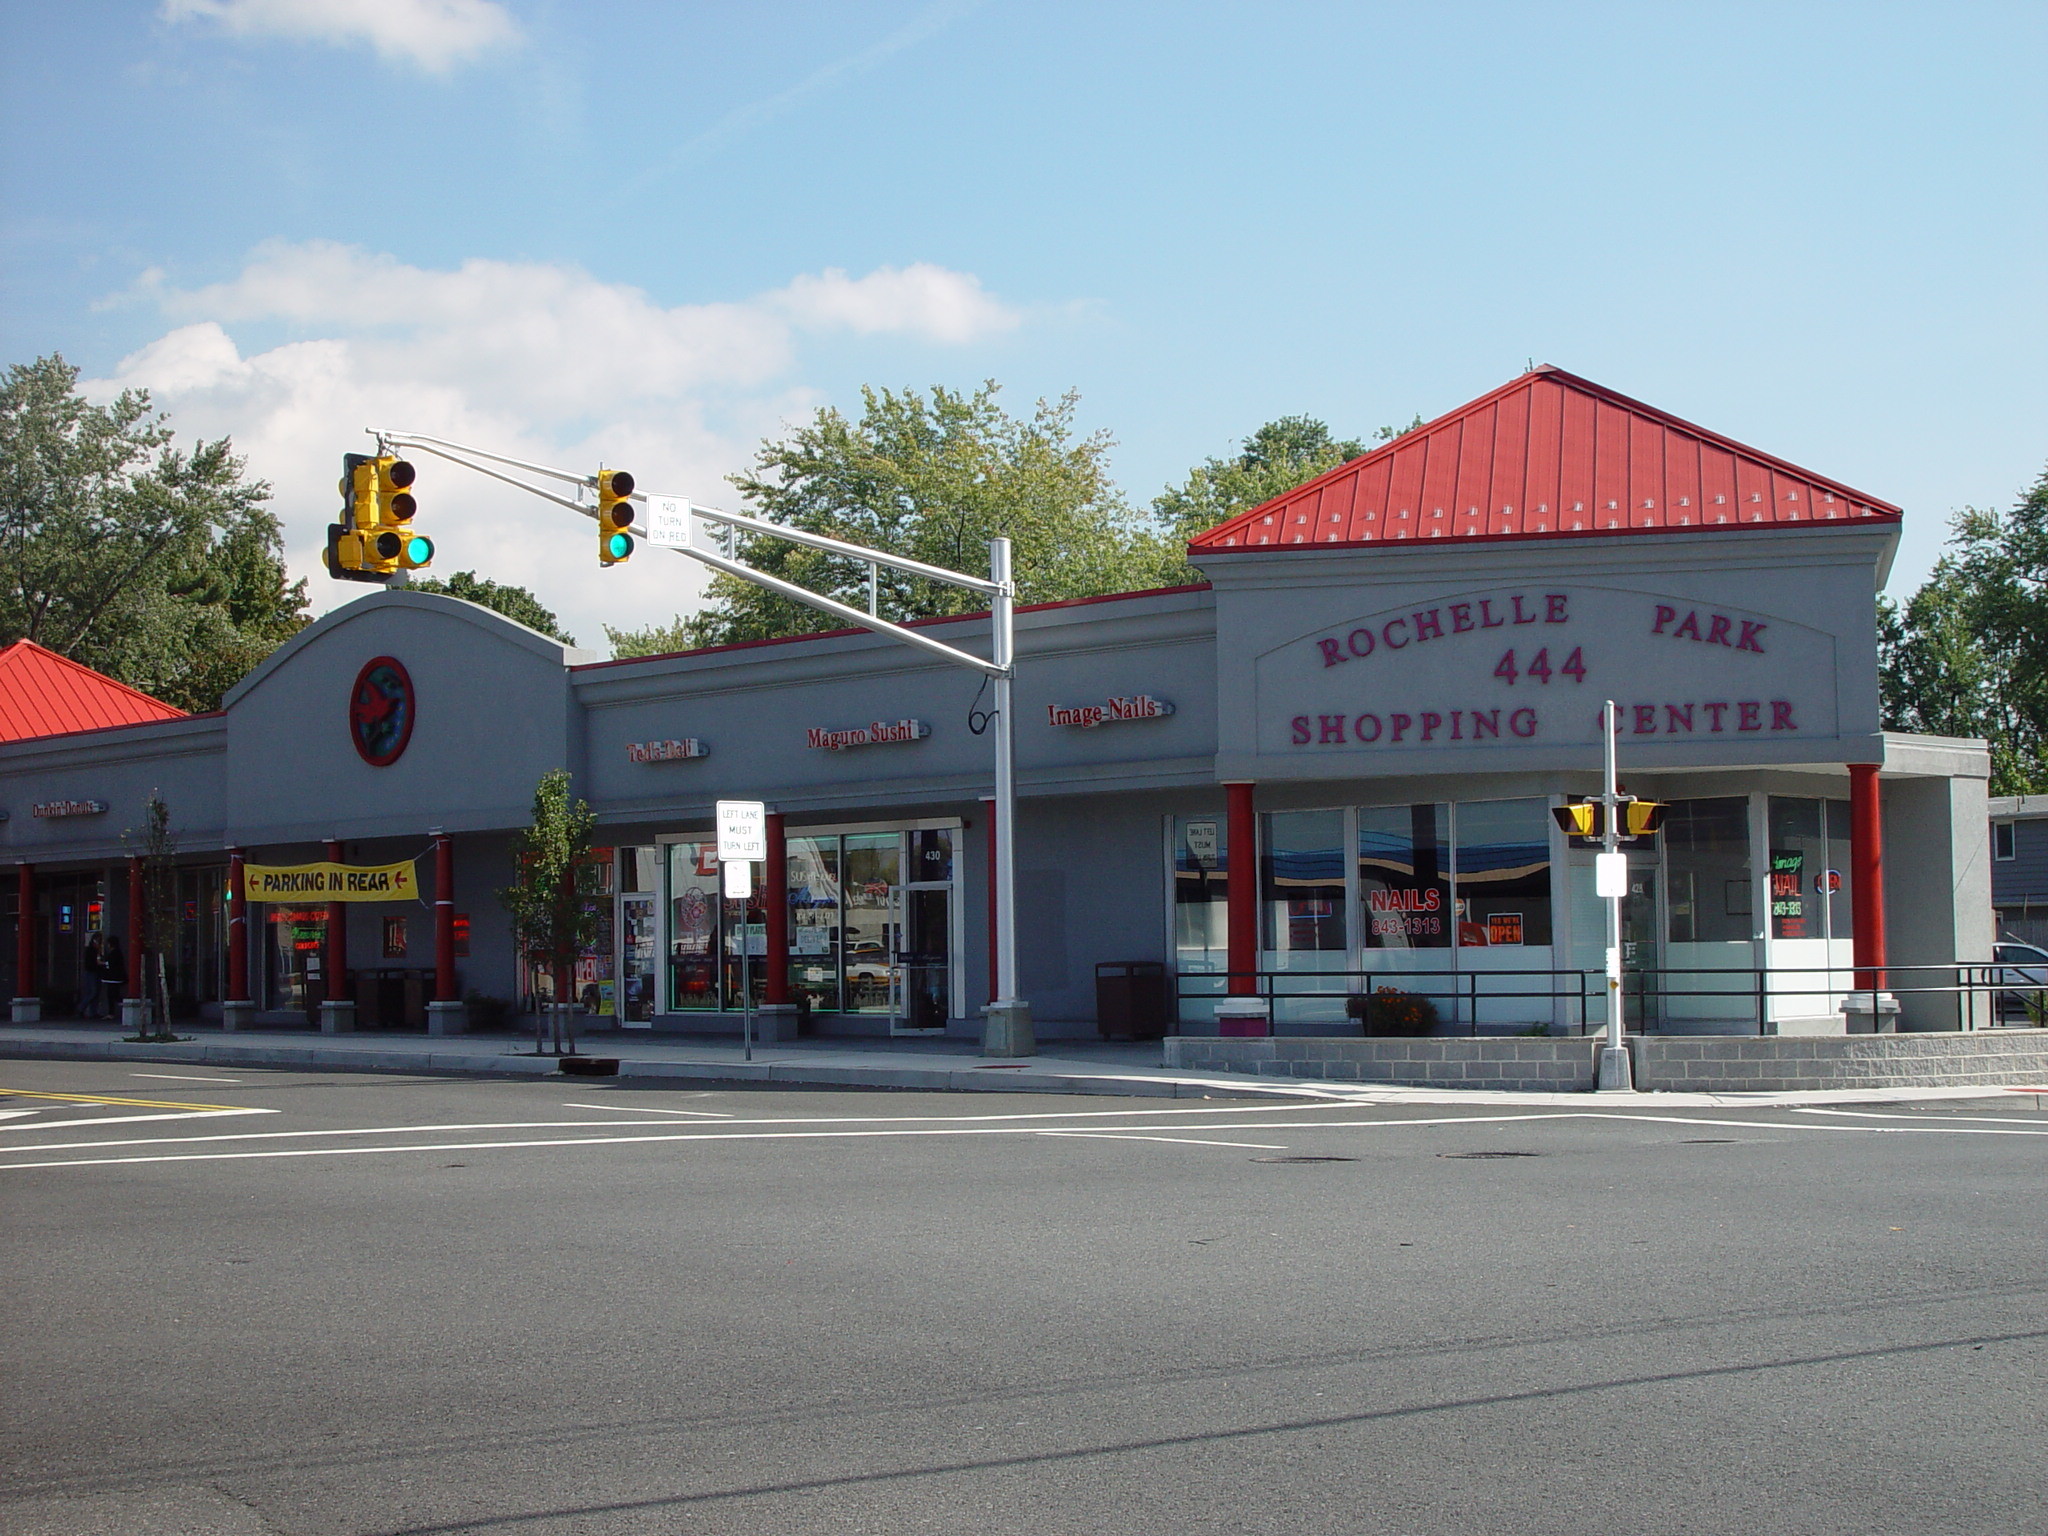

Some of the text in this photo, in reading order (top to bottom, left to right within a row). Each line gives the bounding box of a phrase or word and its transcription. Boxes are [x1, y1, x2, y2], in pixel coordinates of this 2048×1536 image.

[662, 500, 677, 513] NO
[658, 515, 682, 527] TURN
[652, 529, 687, 542] ON RED
[1316, 594, 1768, 668] ROCHELLE PARK
[1493, 646, 1587, 686] 444
[1047, 695, 1156, 728] Image Nails
[1291, 700, 1798, 746] SHOPPING CENTER
[807, 721, 914, 750] Maguro Sushi
[722, 810, 759, 820] LEFT LANE
[729, 825, 752, 835] MUST
[723, 841, 760, 851] TURN LEFT
[925, 850, 941, 861] 430
[263, 871, 390, 892] PARKING IN REAR
[1370, 888, 1441, 913] NAILS
[1370, 917, 1441, 935] 843-1313
[1490, 924, 1521, 942] OPEN
